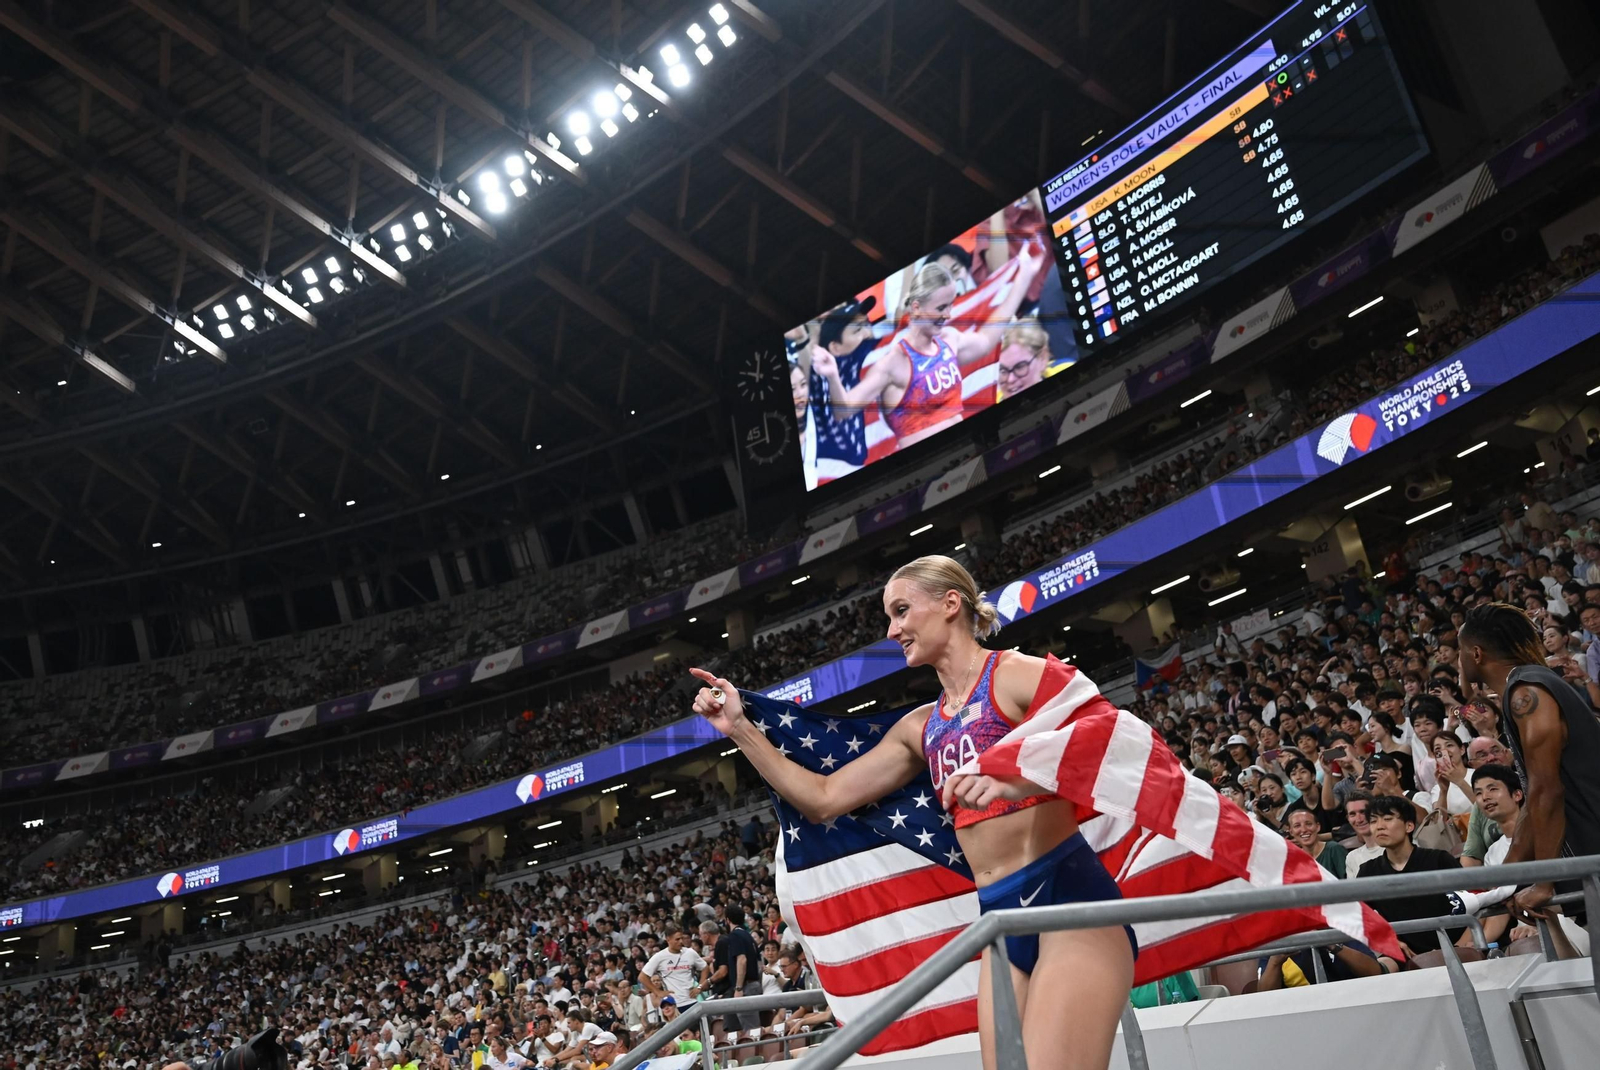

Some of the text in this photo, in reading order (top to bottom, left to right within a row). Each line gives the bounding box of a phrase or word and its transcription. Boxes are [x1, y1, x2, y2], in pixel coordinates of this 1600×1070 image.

[1268, 3, 1357, 72] 4.90 4.95 5.01
[1047, 159, 1090, 193] LIVE RESULT
[1050, 162, 1110, 206] WOMEN'S
[1111, 138, 1146, 167] POLE
[1146, 105, 1192, 140] VAULT
[1201, 71, 1243, 104] FINAL
[1091, 197, 1108, 212] USA
[1113, 185, 1122, 196] K.
[1124, 164, 1156, 190] MOON
[1229, 106, 1241, 119] SB
[1061, 237, 1069, 247] 2
[1094, 210, 1113, 226] USA
[1127, 174, 1166, 206] MORRIS
[1233, 120, 1247, 134] SB
[1064, 118, 1274, 260] 3 SLO T. ŠUTEJ SB 4.80
[1068, 263, 1076, 273] 4
[1102, 236, 1121, 253] CZE
[1125, 228, 1136, 240] A.
[1243, 149, 1256, 163] SB
[1257, 133, 1279, 153] 4.75
[1071, 148, 1284, 287] 5 SUI A. MOSER 4.65
[1075, 163, 1289, 302] 6 USA H. MOLL 4.65
[1112, 280, 1132, 296] USA
[1137, 271, 1148, 282] A.
[1147, 252, 1179, 276] MOLL
[1272, 178, 1294, 198] 4.65
[1116, 295, 1136, 311] NZL
[1140, 285, 1152, 297] O.
[1152, 242, 1220, 291] MCTAGGART
[1277, 193, 1299, 214] 4.65
[1120, 309, 1140, 325] FRA
[1144, 300, 1157, 312] M.
[1157, 273, 1200, 305] BONNIN
[1282, 209, 1305, 229] 4.65
[925, 361, 962, 395] USA
[1378, 360, 1464, 411] WORLD ATHLETICS
[1382, 369, 1467, 421] CHAMPIONSHIPS
[747, 426, 761, 441] 45
[1038, 550, 1095, 583] WORLD ATHLETICS
[1040, 558, 1098, 591] CHAMPIONSHIPS
[1312, 542, 1330, 556] 142
[929, 734, 979, 790] USA
